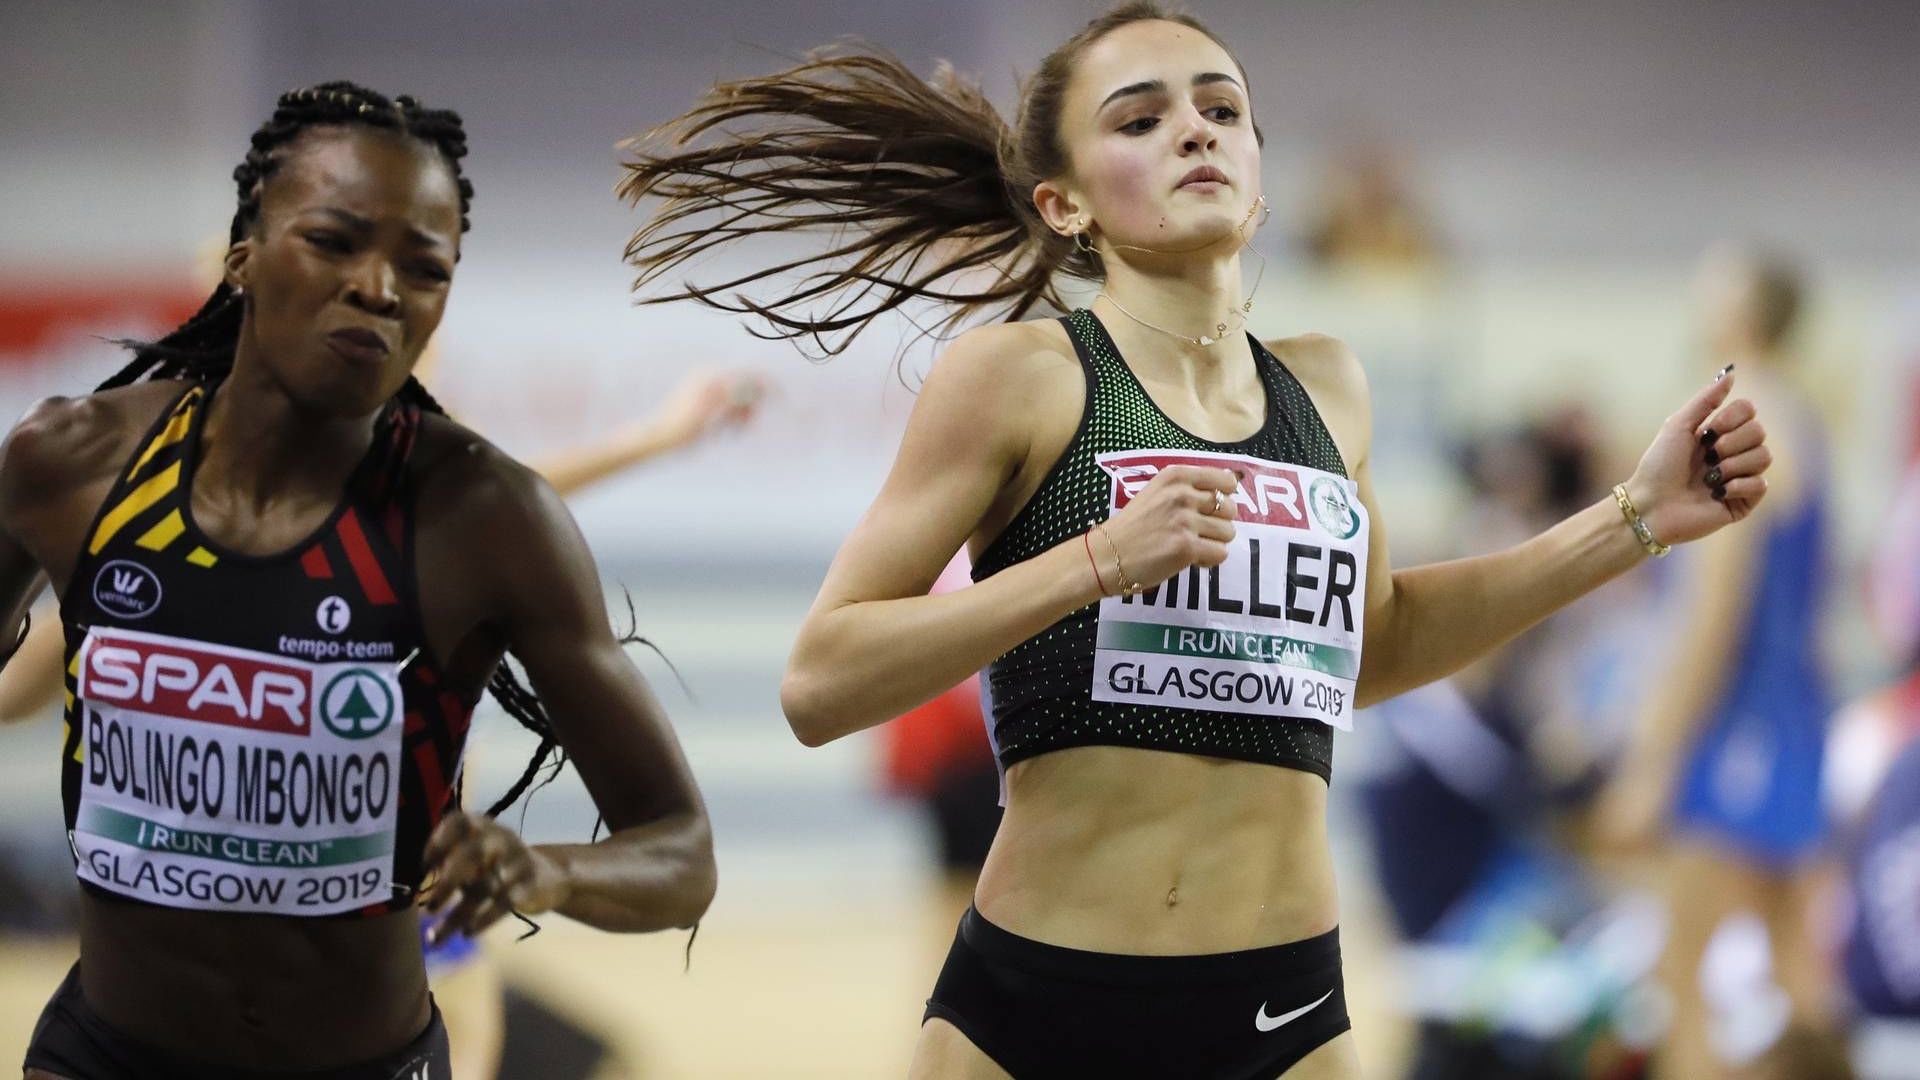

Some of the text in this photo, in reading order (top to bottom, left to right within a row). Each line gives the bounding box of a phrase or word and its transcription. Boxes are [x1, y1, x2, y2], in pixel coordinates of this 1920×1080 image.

[1122, 538, 1357, 633] ILLER
[278, 634, 395, 660] tempo-team
[1163, 628, 1170, 649] I
[1178, 629, 1237, 656] RUN
[90, 646, 308, 726] SPAR
[1108, 662, 1347, 717] GLASGOW 2019
[89, 709, 390, 828] BOLINGO MBONGO
[137, 821, 147, 845] I
[151, 826, 214, 855] RUN
[89, 849, 381, 905] GLASGOW 2019
